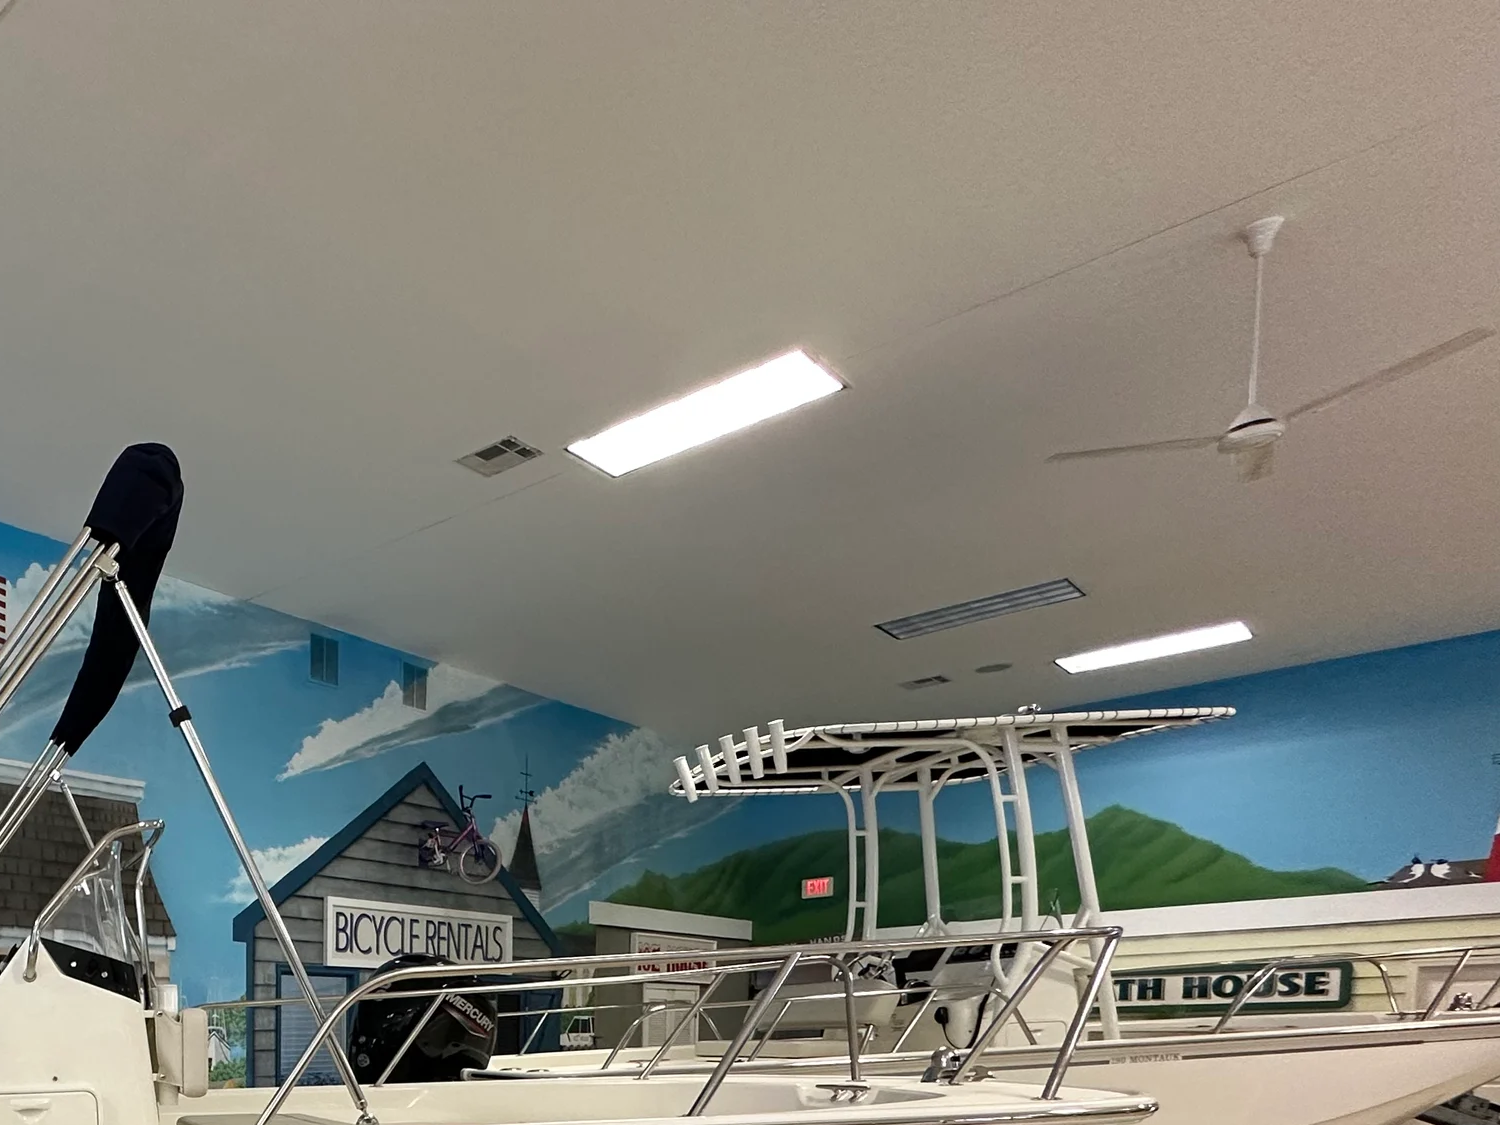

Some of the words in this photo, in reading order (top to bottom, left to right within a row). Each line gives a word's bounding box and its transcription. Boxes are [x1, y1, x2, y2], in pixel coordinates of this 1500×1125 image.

[806, 879, 830, 896] EXIT
[335, 911, 420, 958] BICYCLE
[425, 919, 503, 963] RENTALS
[1113, 978, 1166, 1002] TH
[1182, 971, 1330, 1000] HOUSE
[444, 992, 495, 1032] MERCURY
[1129, 1053, 1181, 1064] MONTAUK
